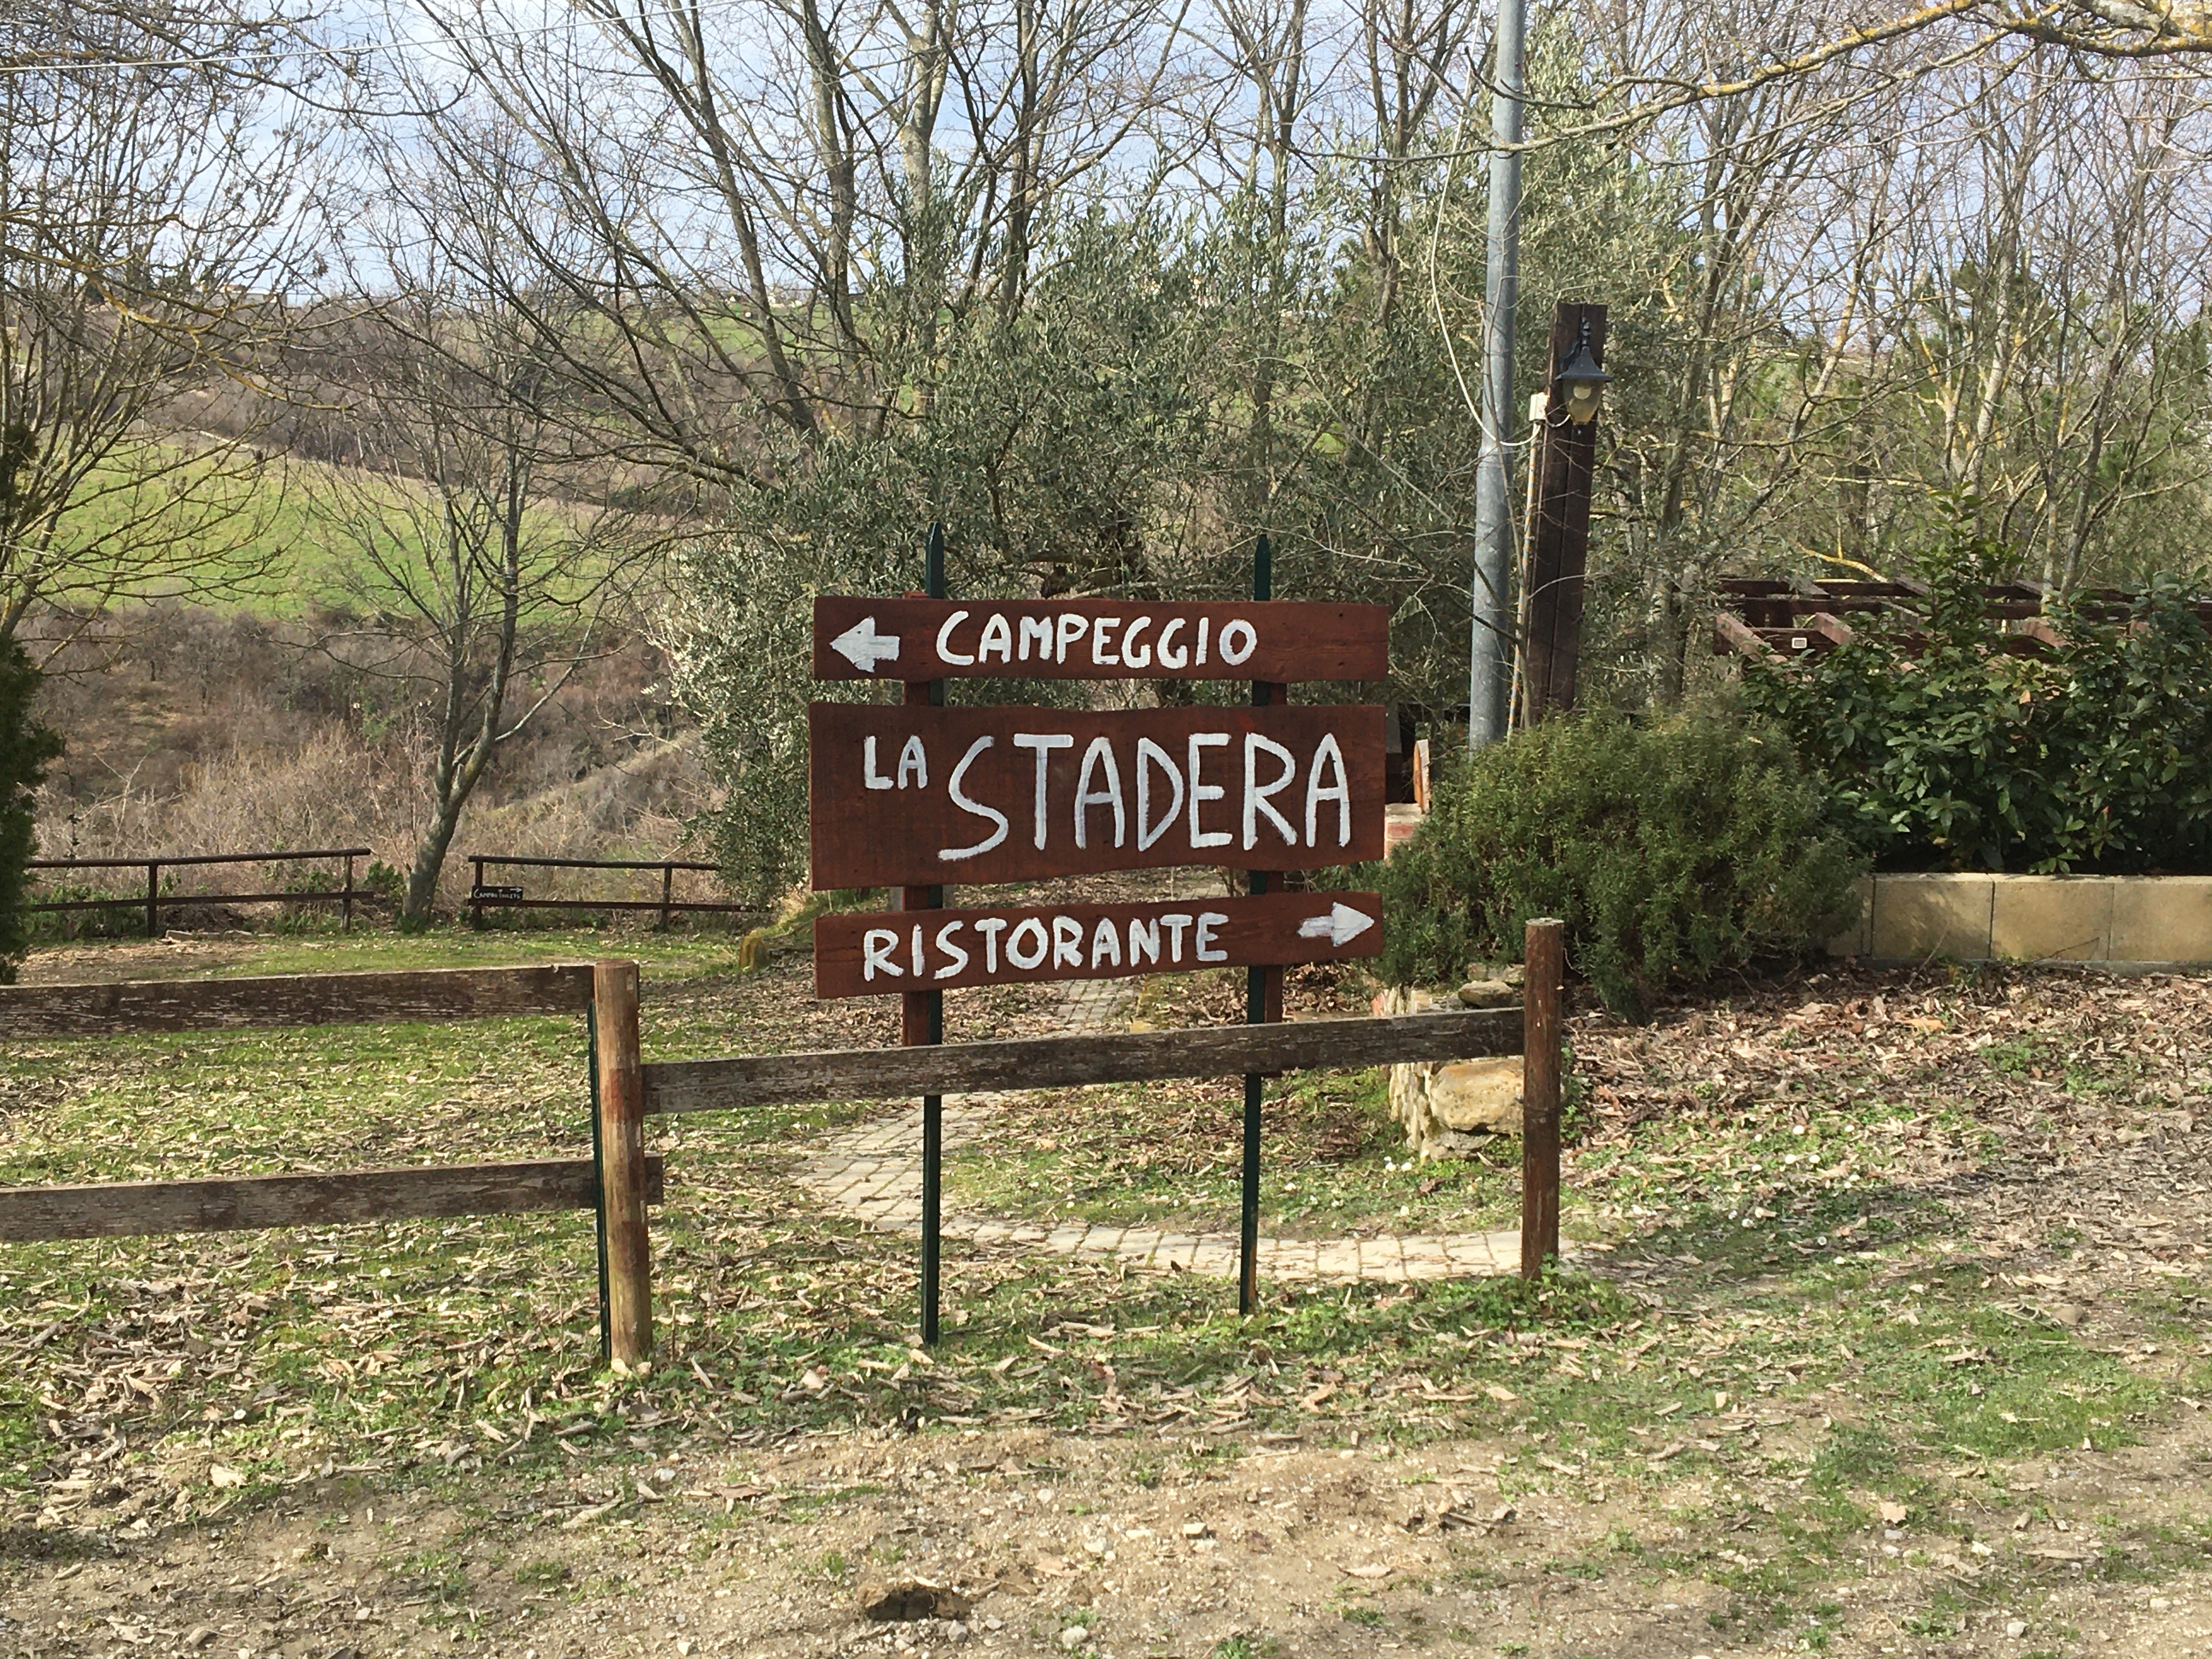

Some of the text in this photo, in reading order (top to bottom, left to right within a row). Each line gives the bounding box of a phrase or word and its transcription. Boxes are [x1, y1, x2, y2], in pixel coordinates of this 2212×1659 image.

[935, 610, 1258, 669] CAMPEGGIO
[863, 731, 1351, 861] LA STADERA
[863, 912, 1229, 982] RISTORANTE
